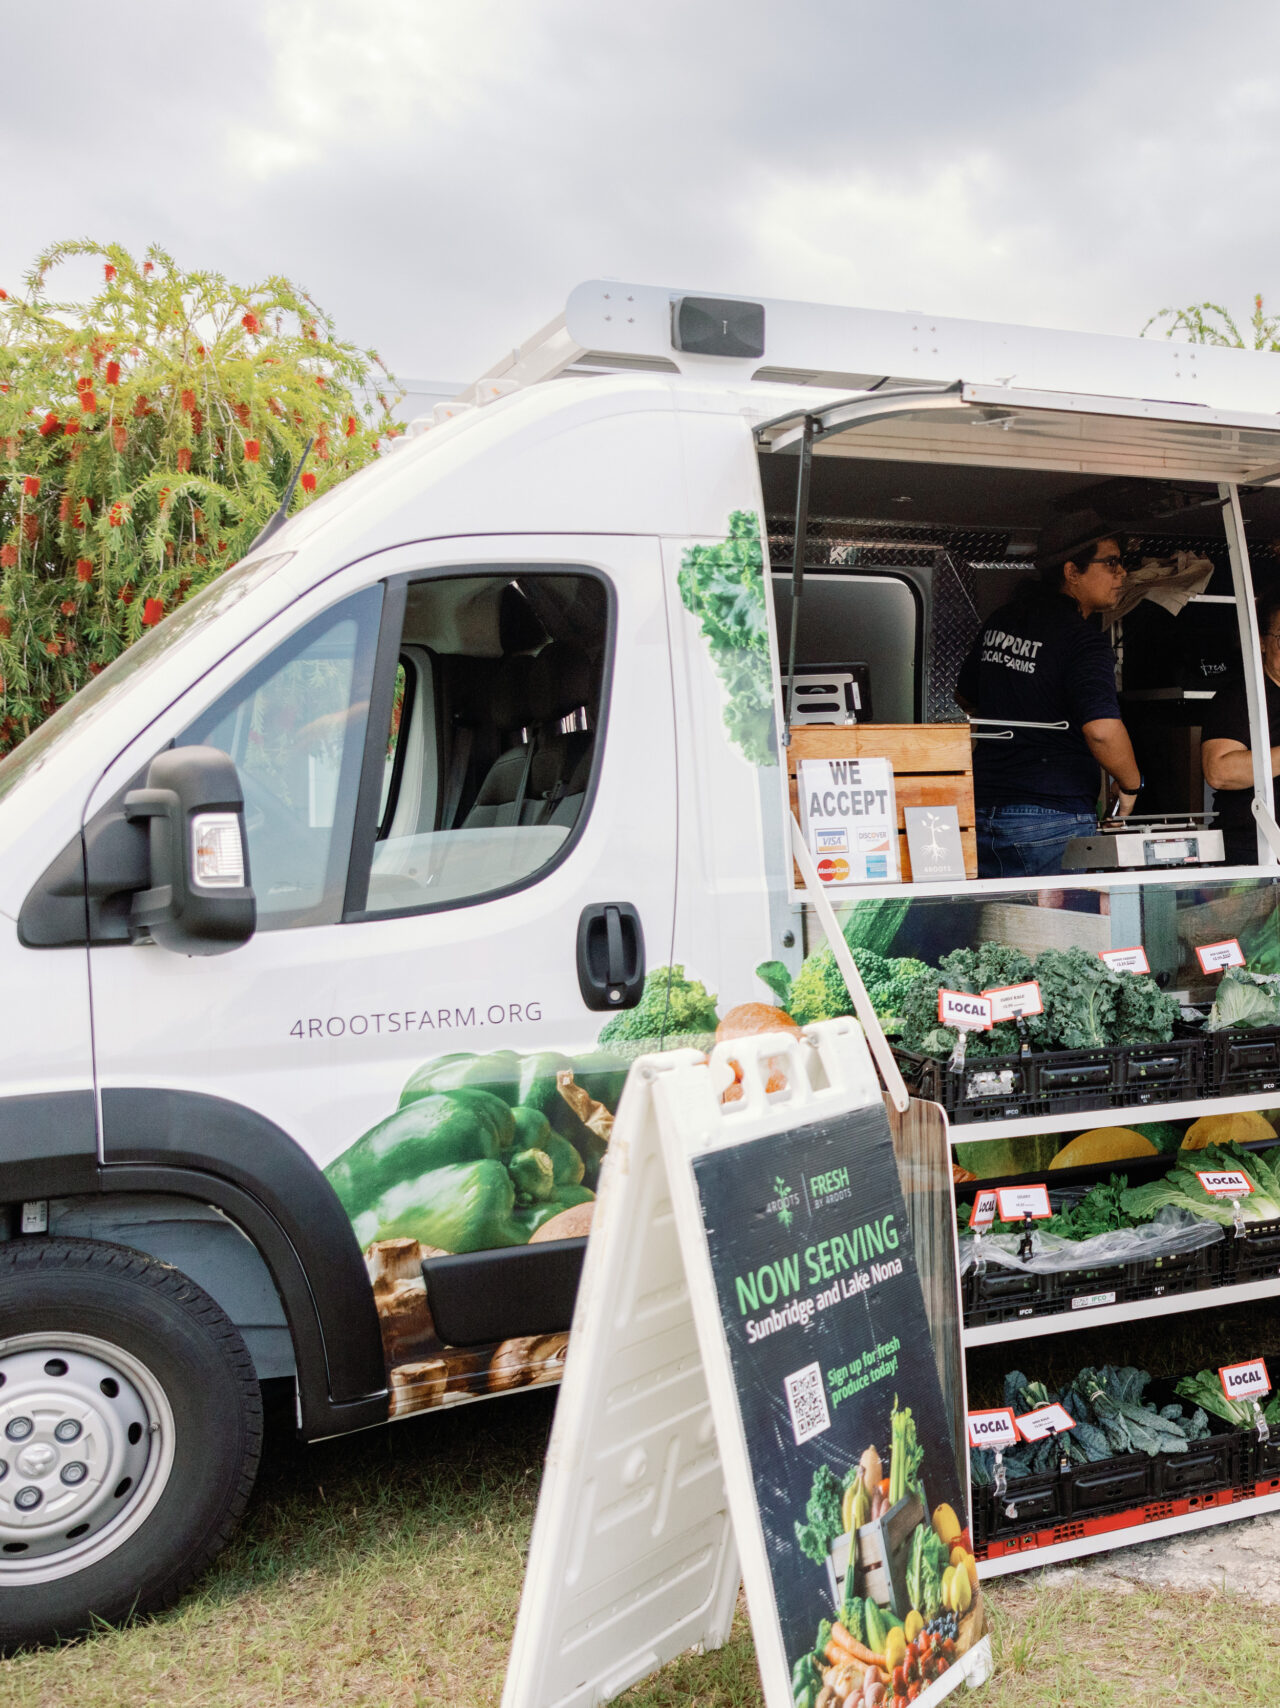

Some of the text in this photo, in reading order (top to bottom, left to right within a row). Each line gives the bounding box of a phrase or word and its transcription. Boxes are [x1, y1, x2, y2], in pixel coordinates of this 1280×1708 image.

[982, 630, 1042, 658] SUPPORT
[1003, 655, 1036, 674] FARMS
[829, 761, 862, 786] WE
[809, 790, 888, 817] ACCEPT
[823, 837, 842, 846] VISA
[858, 831, 887, 840] DISCOVER
[948, 1000, 987, 1016] LOCAL
[289, 1002, 542, 1039] 4ROOTSFARM.ORG
[809, 1166, 850, 1198] FRESH
[1206, 1176, 1242, 1185] LOCAL
[814, 1199, 824, 1209] BY
[978, 1200, 995, 1213] LOCAL
[735, 1214, 900, 1315] NOW SERVING
[745, 1258, 903, 1344] Sunbridge and Lake Nona
[1091, 1294, 1107, 1302] IFCO
[827, 1335, 901, 1387] Sign up for fresh
[831, 1355, 899, 1409] produce today!
[1228, 1370, 1262, 1386] LOCAL
[973, 1419, 1010, 1435] LOCAL
